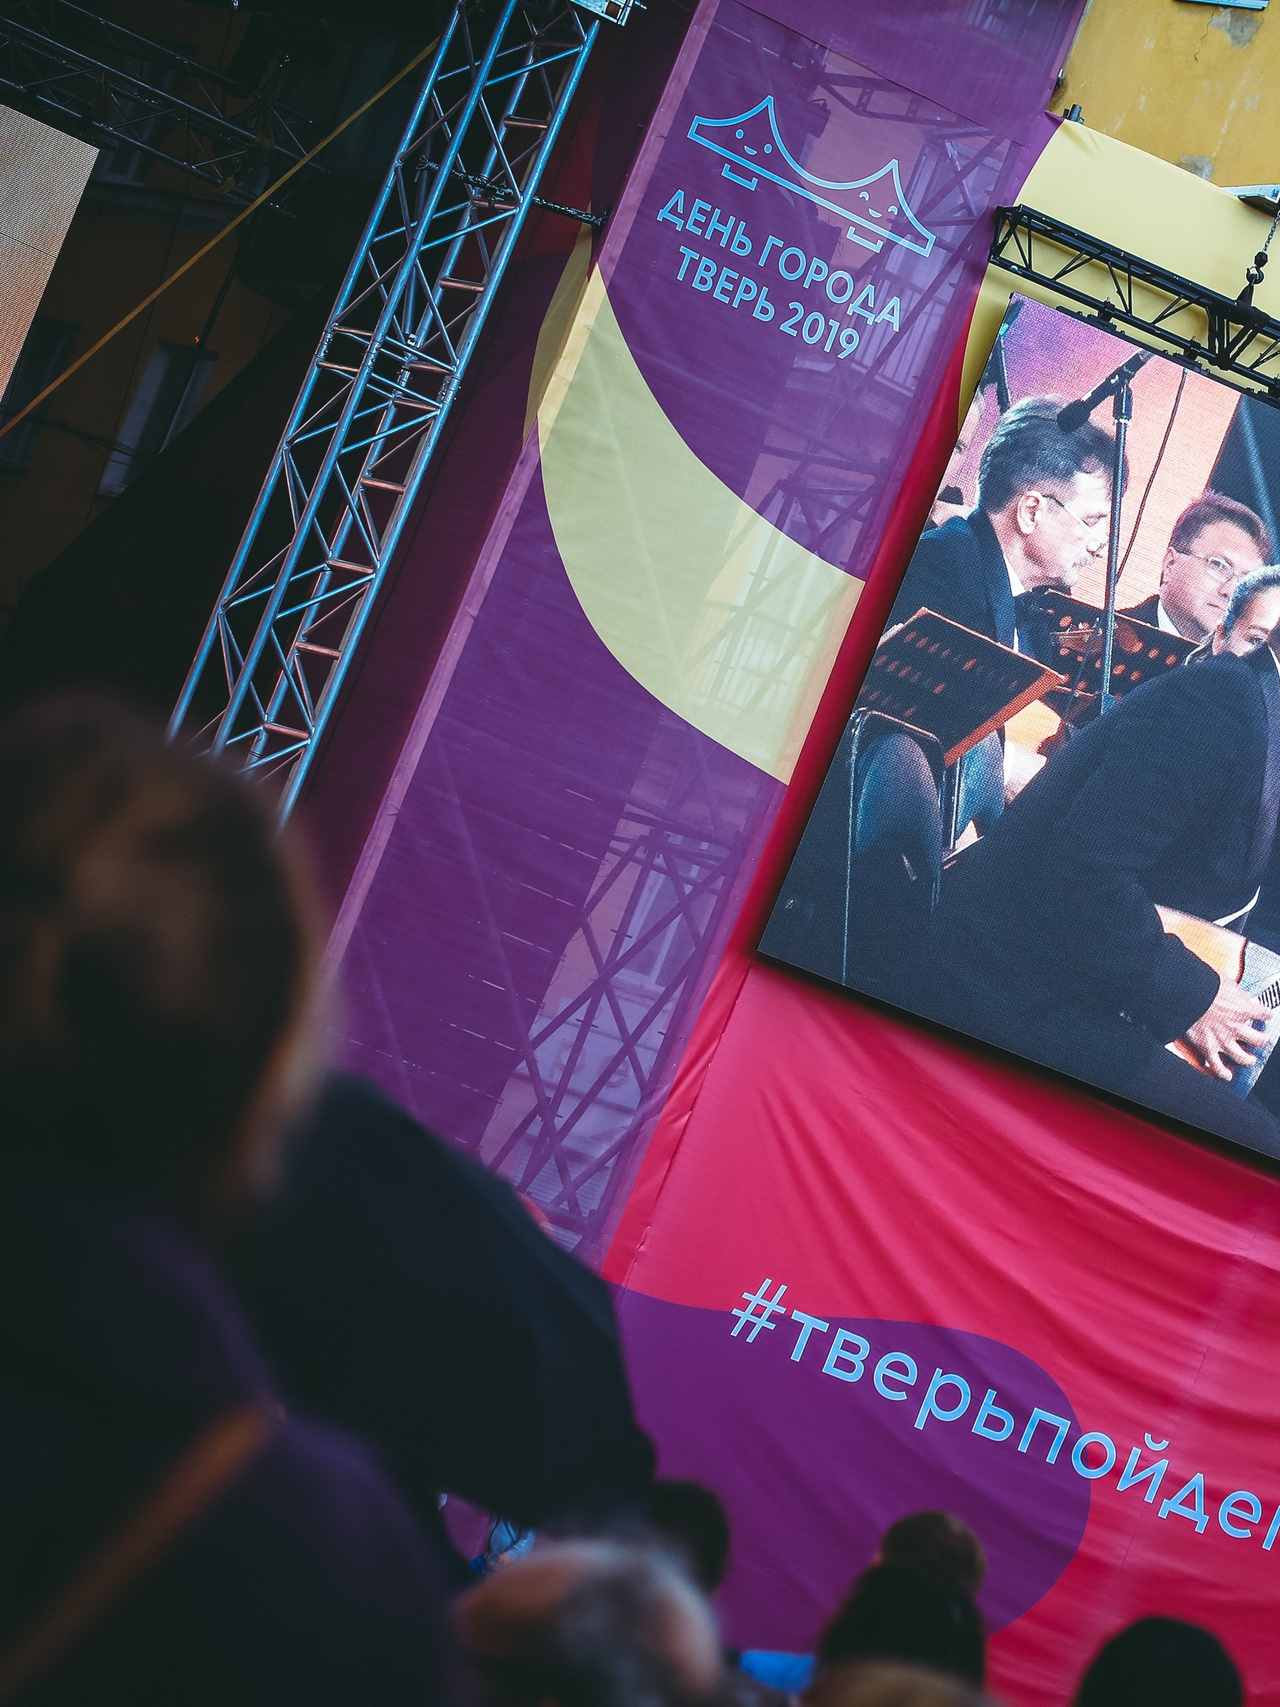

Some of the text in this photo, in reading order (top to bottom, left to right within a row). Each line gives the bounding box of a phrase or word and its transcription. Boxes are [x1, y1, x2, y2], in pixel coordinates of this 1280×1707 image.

[658, 190, 901, 332] ДЕНЬ ГОРОДА
[676, 246, 860, 359] ТВЕРЬ 2019
